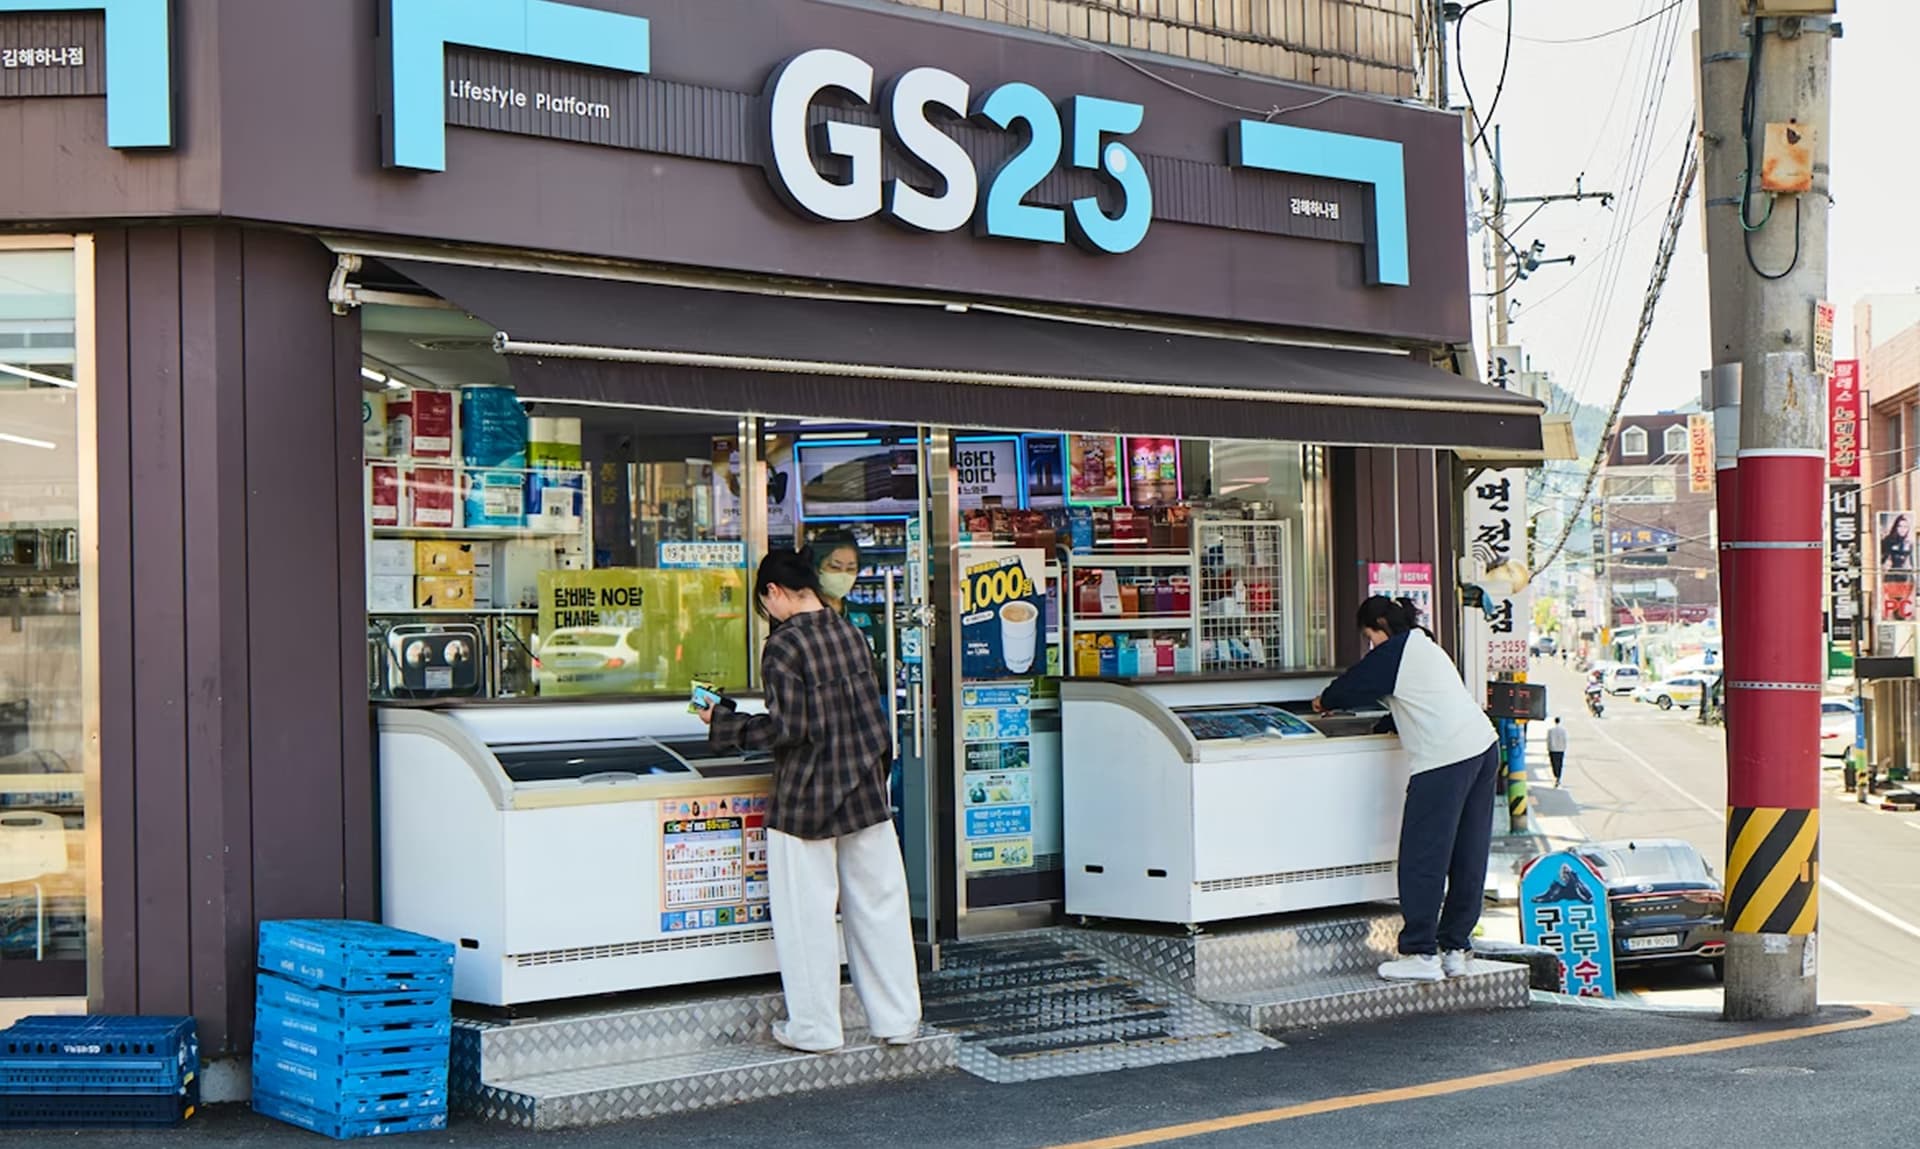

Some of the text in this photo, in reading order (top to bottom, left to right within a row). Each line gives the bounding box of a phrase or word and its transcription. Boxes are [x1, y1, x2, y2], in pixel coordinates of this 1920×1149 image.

[2, 46, 84, 67] 김해하나점
[449, 79, 611, 119] Lifestyle Platform
[769, 48, 1154, 254] GS25
[1289, 198, 1339, 219] 김해하나점
[554, 587, 596, 608] 담배는
[1883, 600, 1914, 618] PC
[554, 610, 600, 630] 대세는
